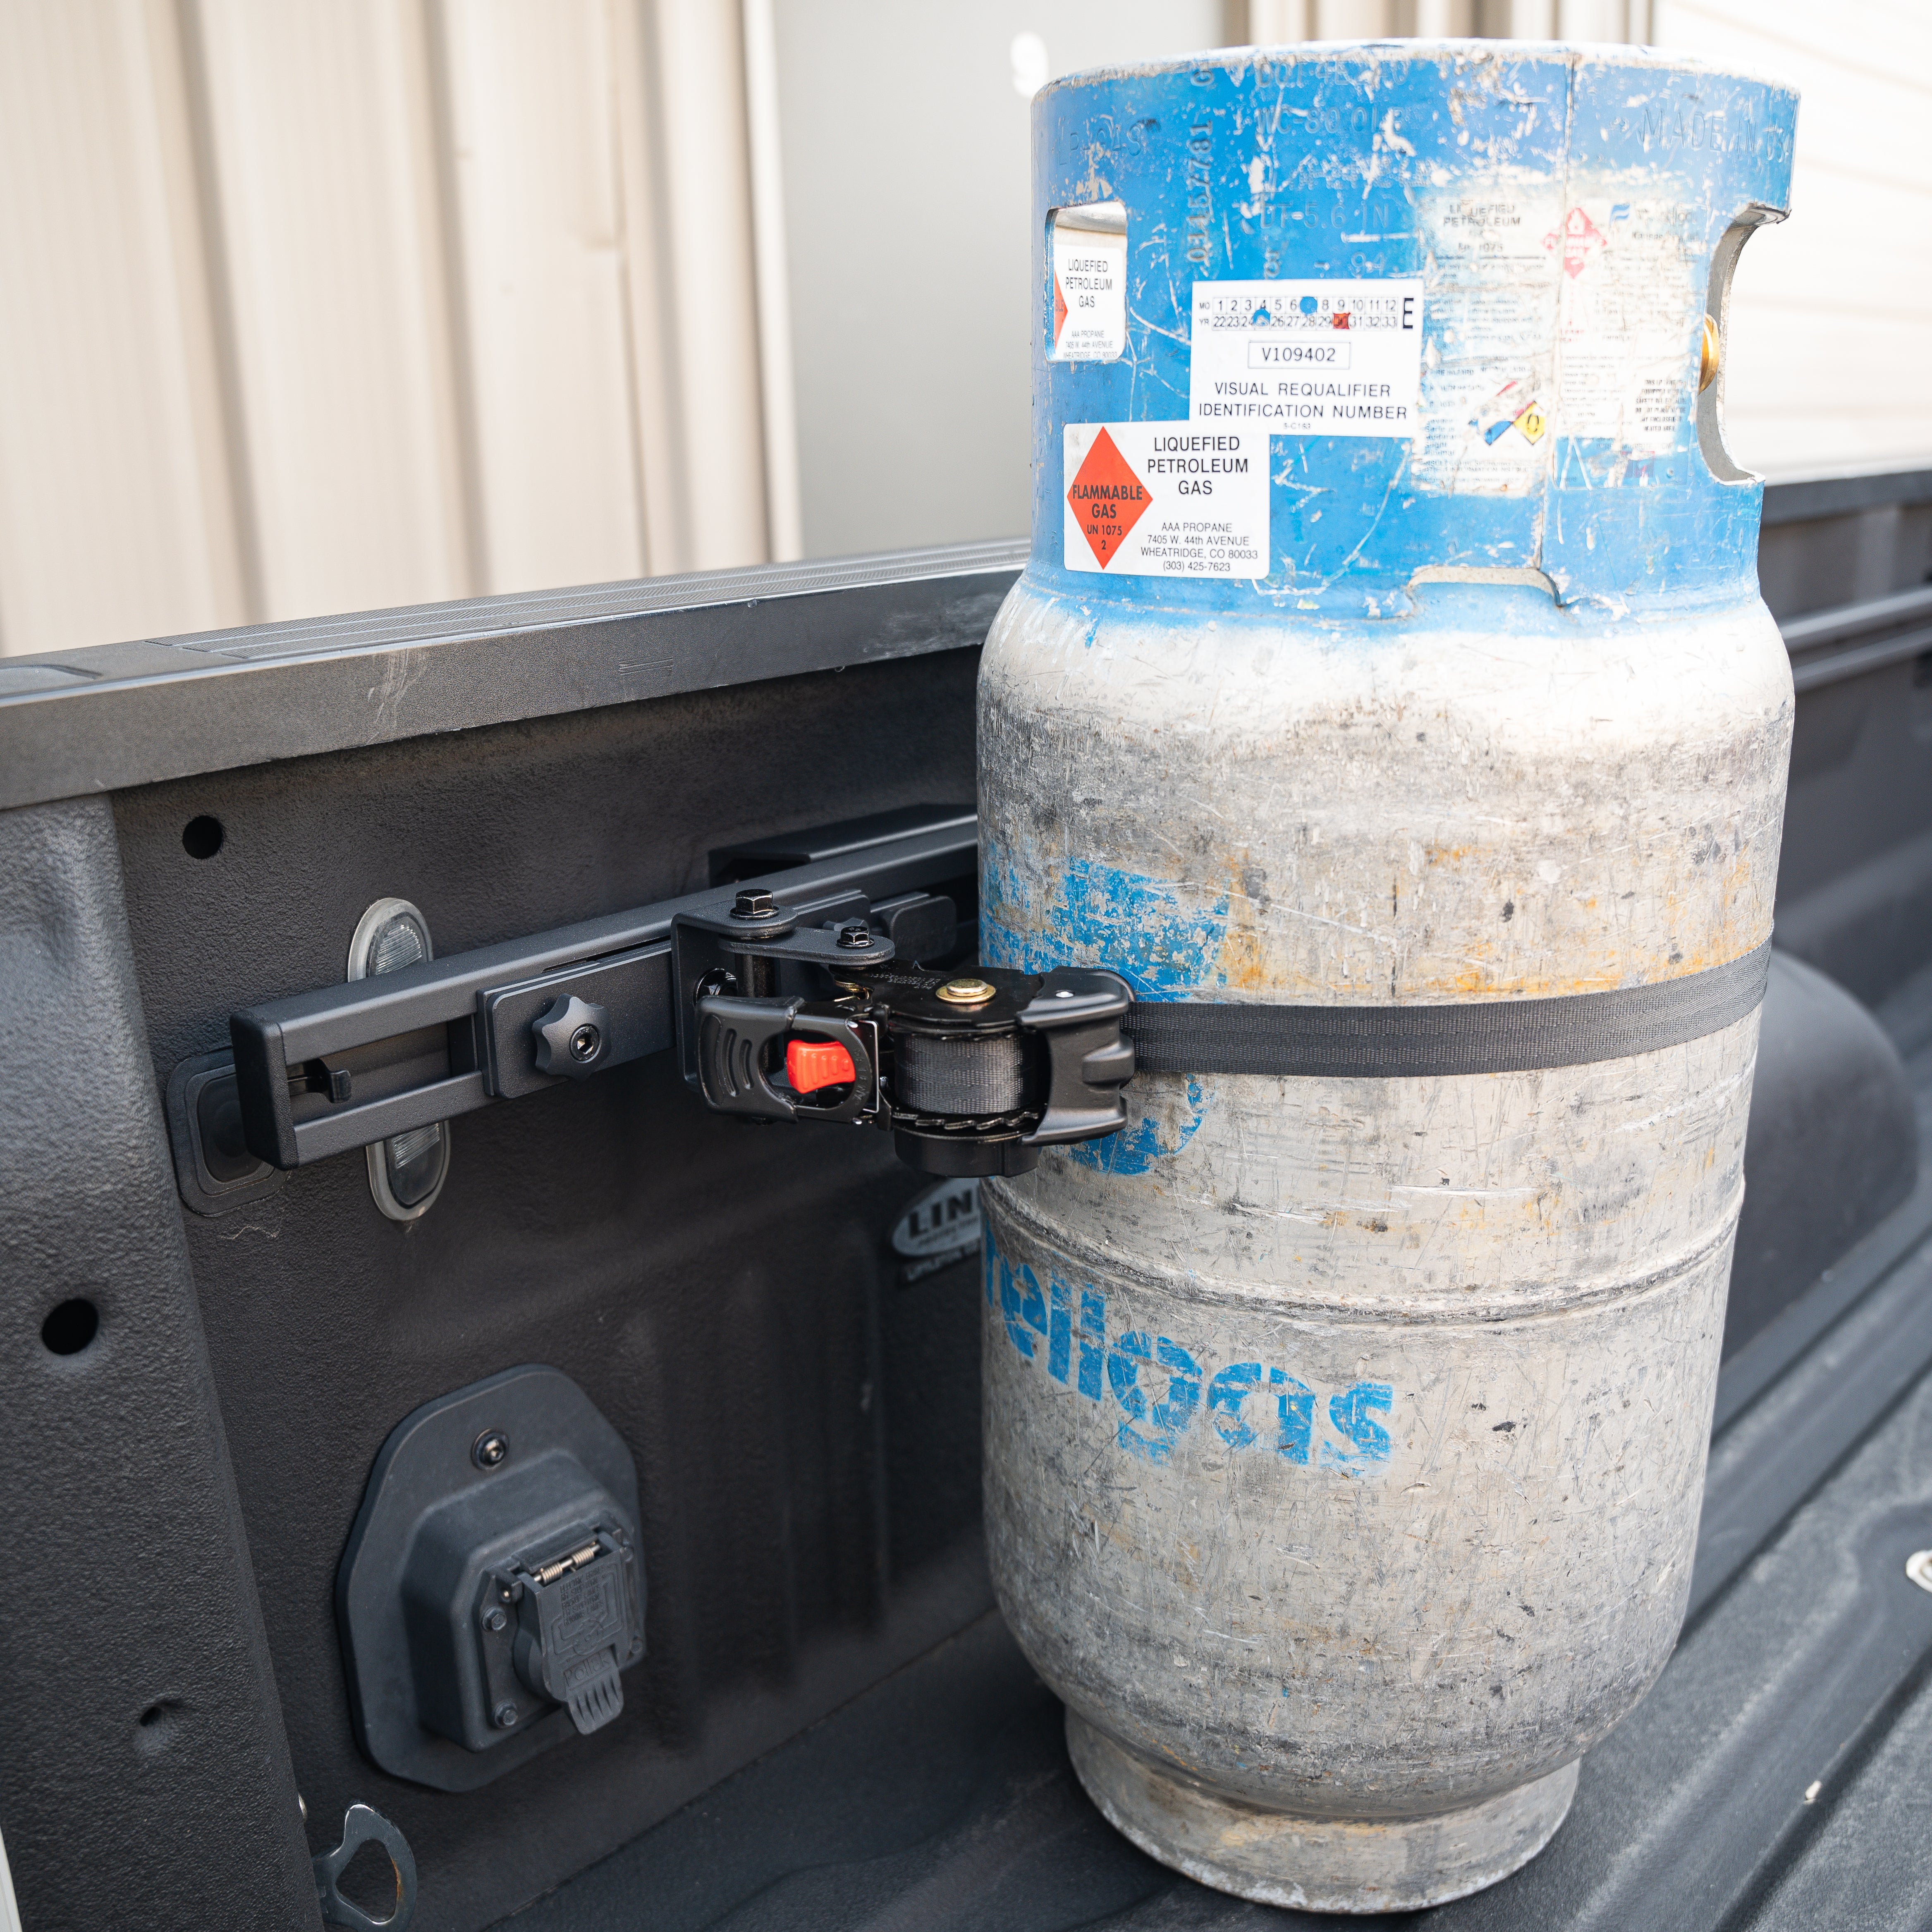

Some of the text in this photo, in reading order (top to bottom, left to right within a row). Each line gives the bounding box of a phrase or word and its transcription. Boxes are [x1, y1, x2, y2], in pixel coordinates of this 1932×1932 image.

[1449, 204, 1515, 218] LIUEFIED
[1068, 259, 1108, 272] LIQUEFIED
[1066, 277, 1112, 290] PETROLEUM
[1078, 296, 1095, 308] GAS
[1219, 300, 1222, 310] 1
[1231, 300, 1237, 311] 2
[1245, 300, 1252, 311] 3
[1275, 300, 1282, 310] 5
[1290, 299, 1297, 310] 6
[1322, 299, 1329, 311] 8
[1338, 300, 1344, 311] 9
[1352, 300, 1363, 310] 10
[1370, 300, 1379, 310] 11
[1385, 300, 1396, 311] 12
[1403, 298, 1414, 329] E
[1214, 316, 1225, 327] 22
[1227, 316, 1239, 327] 23
[1272, 316, 1284, 327] 26
[1287, 316, 1299, 327] 27
[1303, 316, 1315, 327] 28
[1319, 316, 1331, 327] 29
[1350, 316, 1362, 327] 31
[1366, 316, 1380, 328] 32
[1382, 316, 1396, 328] 33
[1262, 347, 1335, 361] V109402
[1215, 383, 1390, 397] VISUAL REQUALIFIER
[1199, 403, 1407, 419] IDENTIFICATION NUMBER
[1154, 436, 1240, 451] LIQUEFIED
[1148, 459, 1248, 473] PETROLEUM
[1073, 484, 1142, 500] FLAMMABLE
[1179, 480, 1212, 495] GAS
[1092, 503, 1117, 519] GAS
[1087, 524, 1122, 536] UN 1075
[1162, 523, 1232, 533] AAA PROPANE
[1101, 540, 1106, 550] 2
[1148, 535, 1249, 546] 7405 W. 44th AVENUE
[1141, 547, 1258, 559] WHEATRIDGE, CO 80033
[1163, 561, 1231, 572] (303) 425-7623
